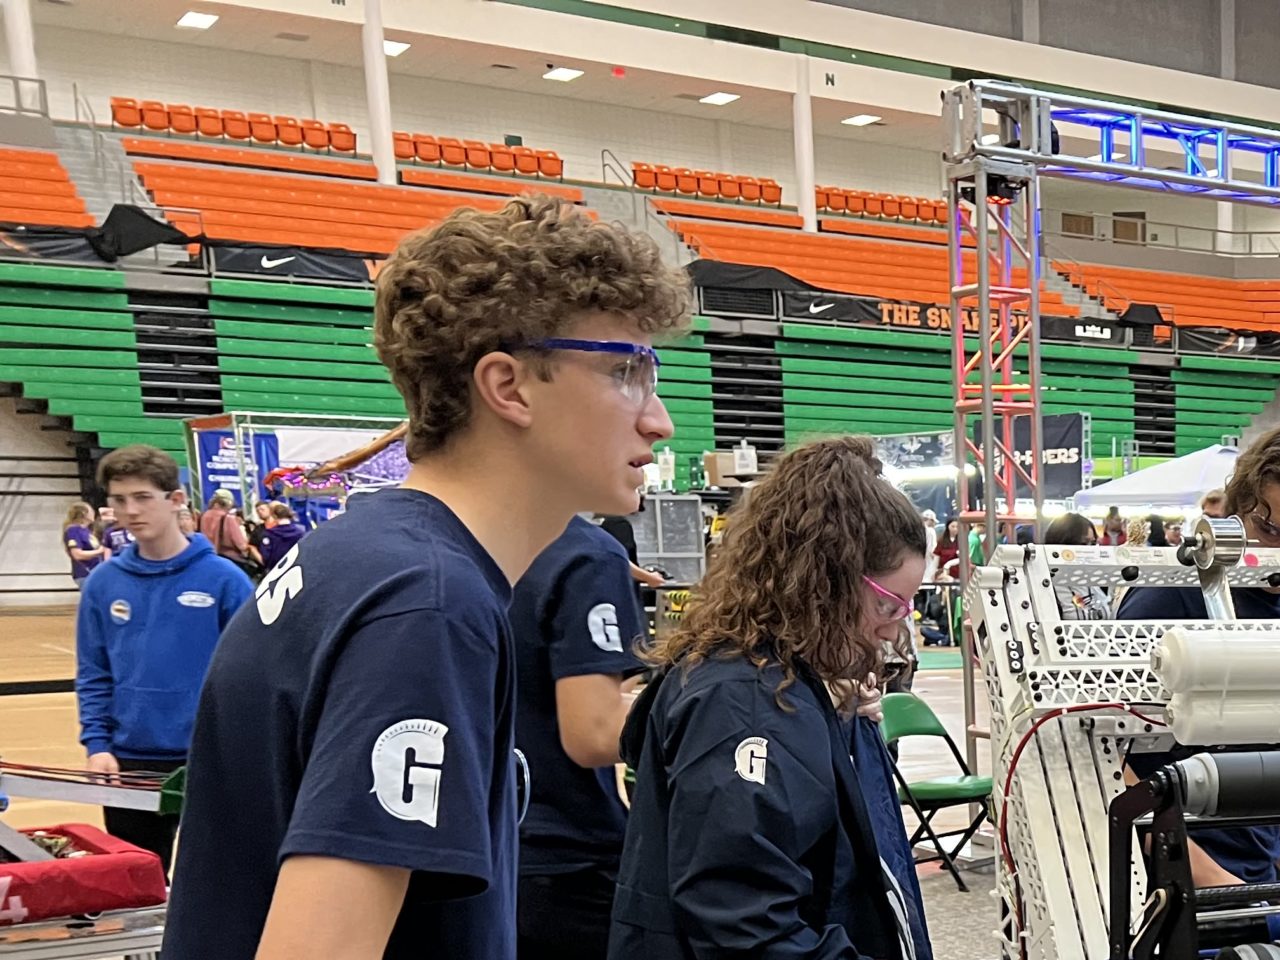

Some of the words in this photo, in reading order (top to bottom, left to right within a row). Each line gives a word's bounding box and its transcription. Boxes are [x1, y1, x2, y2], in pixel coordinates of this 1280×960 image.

[824, 71, 835, 87] N
[878, 302, 921, 326] THE
[587, 603, 624, 653] G
[370, 718, 449, 828] G
[734, 736, 769, 785] G
